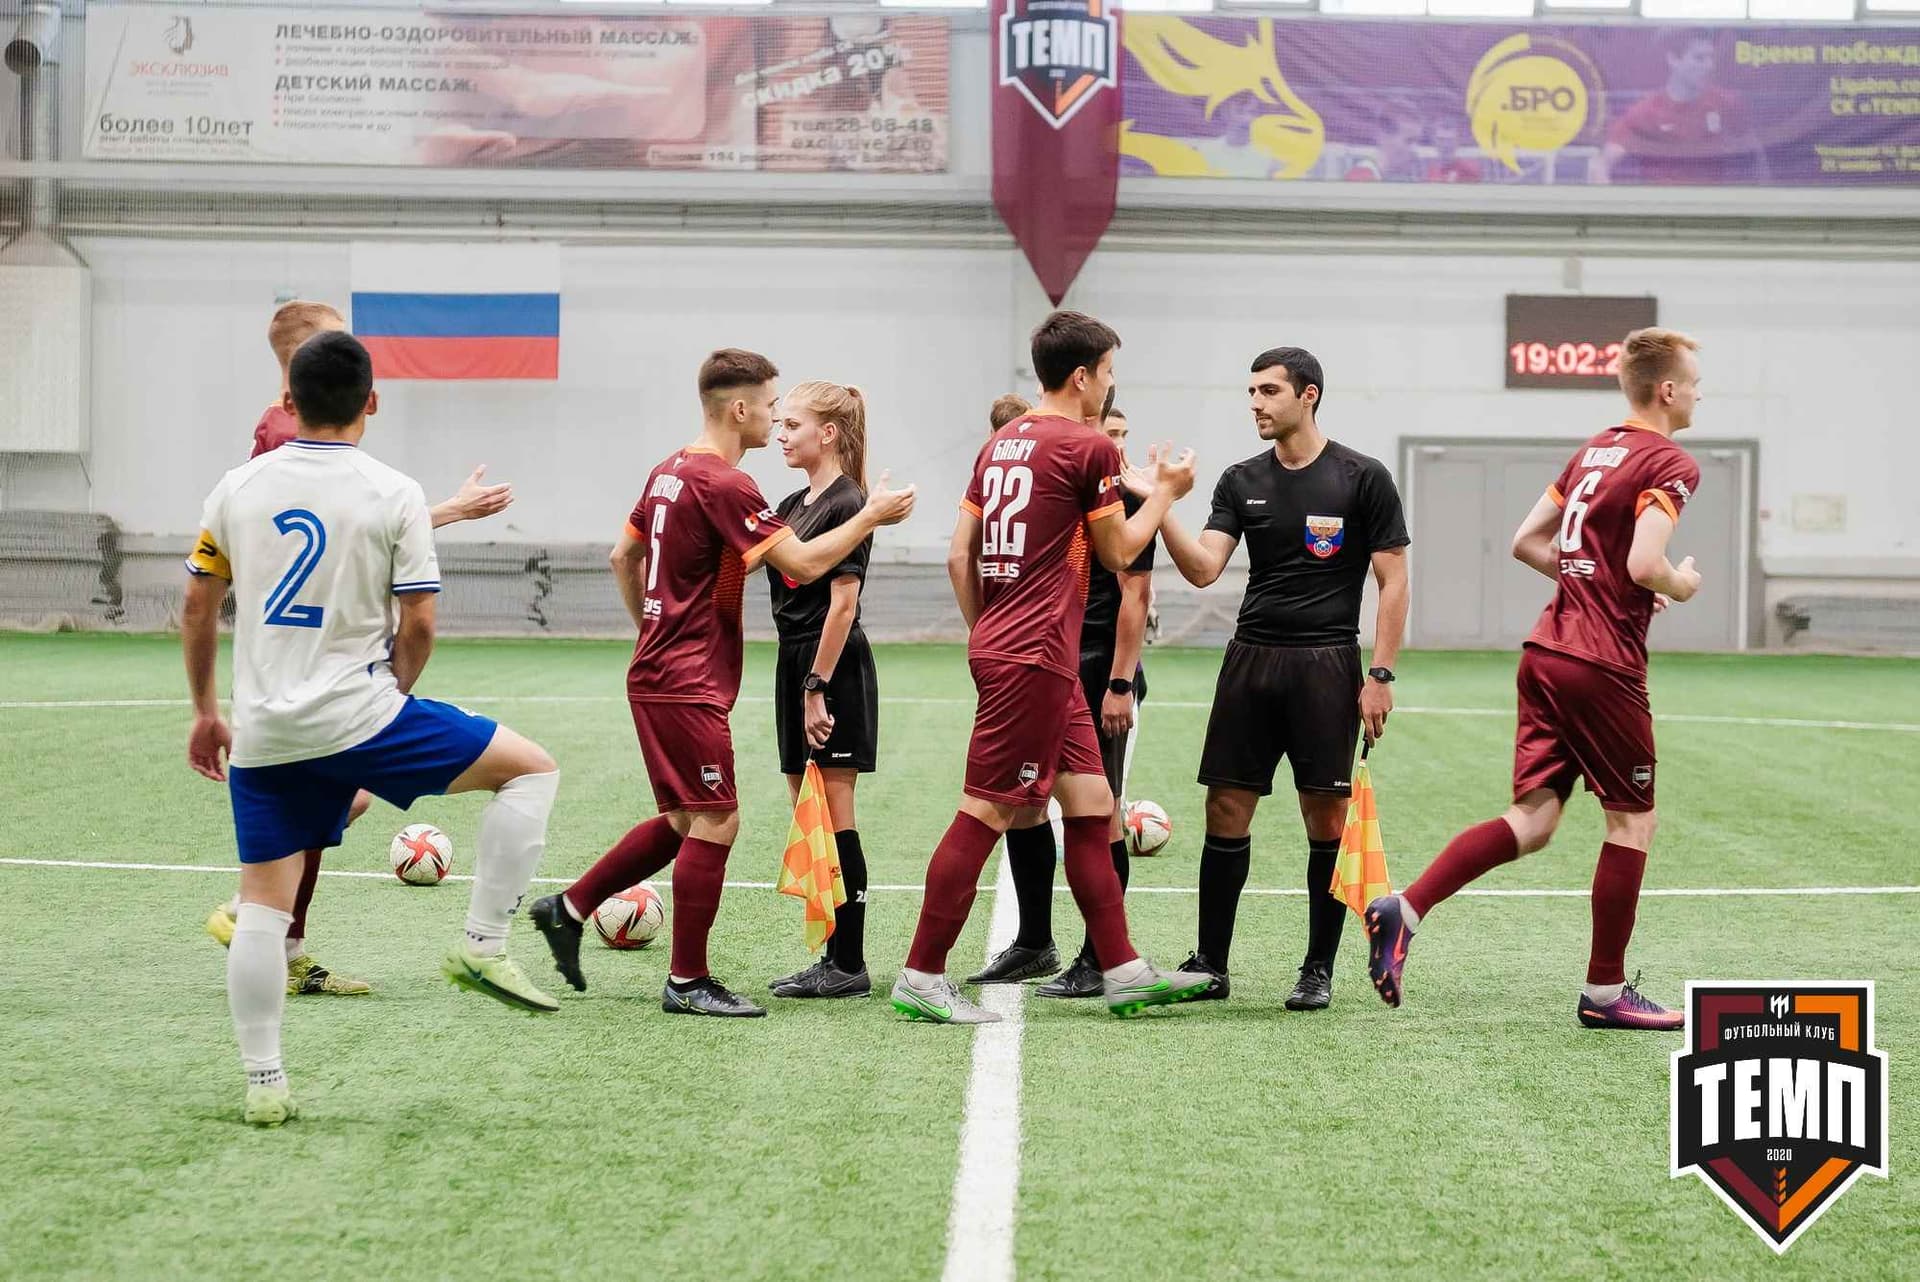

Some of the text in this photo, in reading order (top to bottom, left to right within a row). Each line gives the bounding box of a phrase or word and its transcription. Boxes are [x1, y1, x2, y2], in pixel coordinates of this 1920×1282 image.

[1011, 19, 1106, 70] ТЕМП
[1735, 40, 1815, 68] Время
[275, 74, 372, 93] ДЕТСКИЙ
[100, 113, 255, 136] более 10лет
[1509, 341, 1623, 376] 19:02:2
[991, 438, 1037, 462] БАБИЧ
[982, 465, 1034, 557] 22
[1560, 470, 1603, 553] 6
[263, 508, 327, 629] 2
